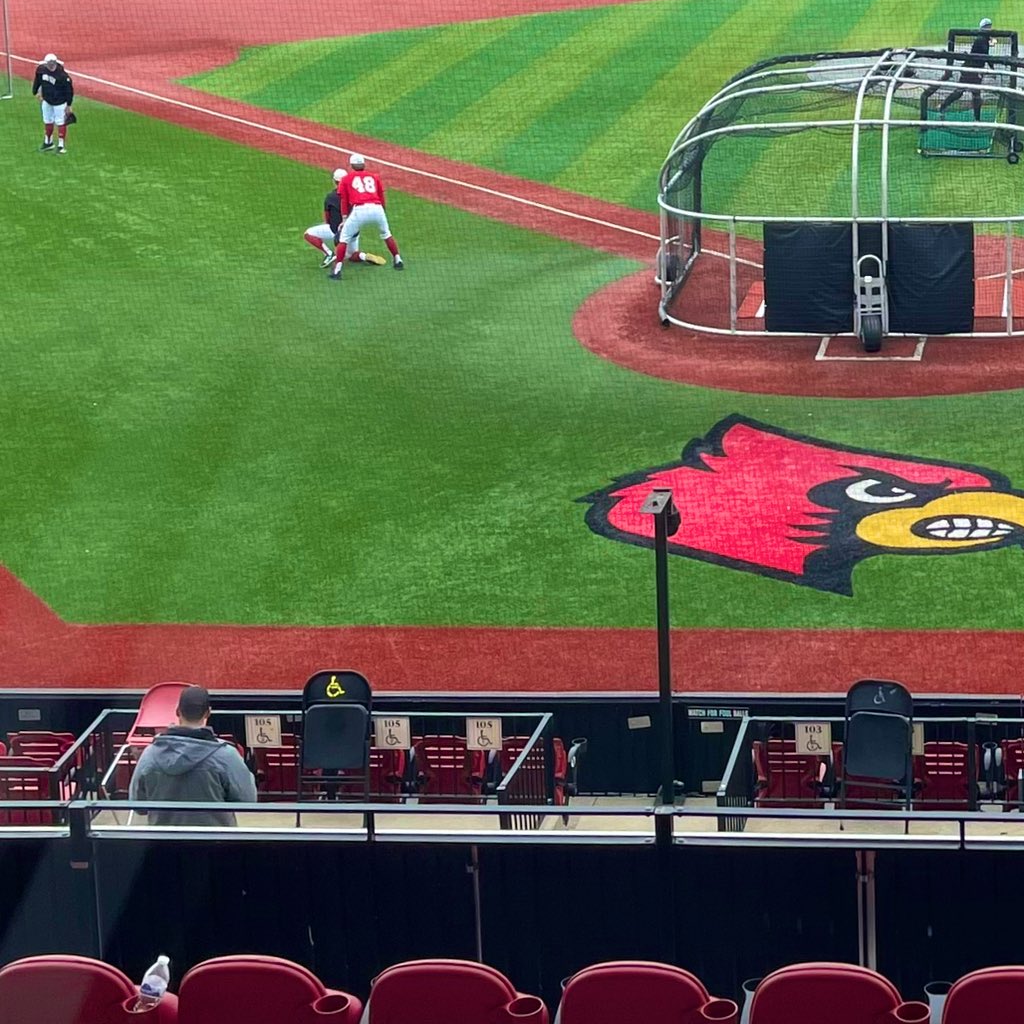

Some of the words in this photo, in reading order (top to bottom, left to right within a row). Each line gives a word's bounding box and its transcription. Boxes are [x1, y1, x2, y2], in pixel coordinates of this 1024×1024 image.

[352, 175, 377, 194] 48
[255, 718, 272, 726] 105
[384, 720, 401, 728] 105
[476, 721, 493, 729] 105
[805, 725, 822, 734] 103
